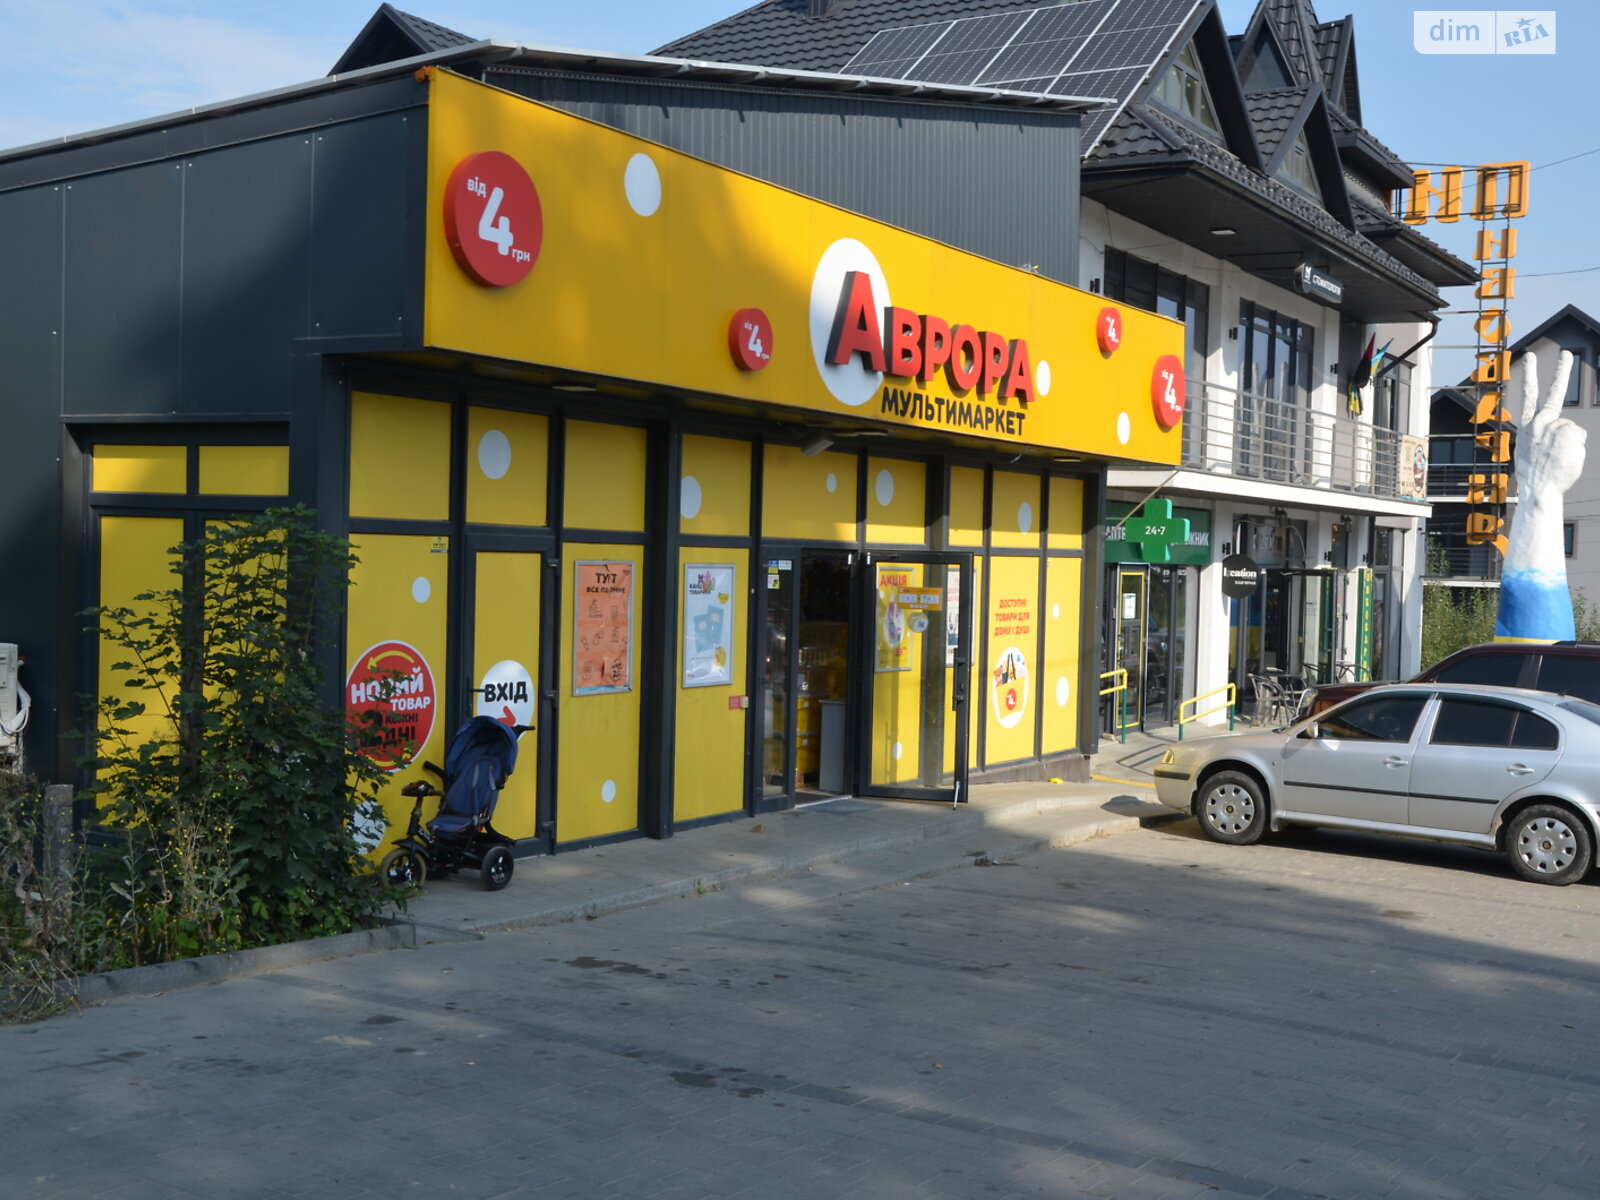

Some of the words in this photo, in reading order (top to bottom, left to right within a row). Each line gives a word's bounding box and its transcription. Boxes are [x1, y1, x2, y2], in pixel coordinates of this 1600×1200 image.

[466, 176, 487, 198] від
[478, 186, 514, 256] 4
[511, 248, 530, 263] грн
[748, 325, 763, 357] 4
[1107, 318, 1117, 342] 4
[1165, 373, 1177, 410] 4
[881, 386, 1026, 436] МУЛЬТИМАРКЕТ
[595, 572, 617, 584] ТУТ
[880, 575, 907, 587] АКЦІЯ
[995, 612, 1018, 622] ТОВАРИ
[1018, 611, 1030, 621] ДЛЯ
[485, 681, 528, 703] ВХІД
[390, 696, 430, 712] ТОВАР
